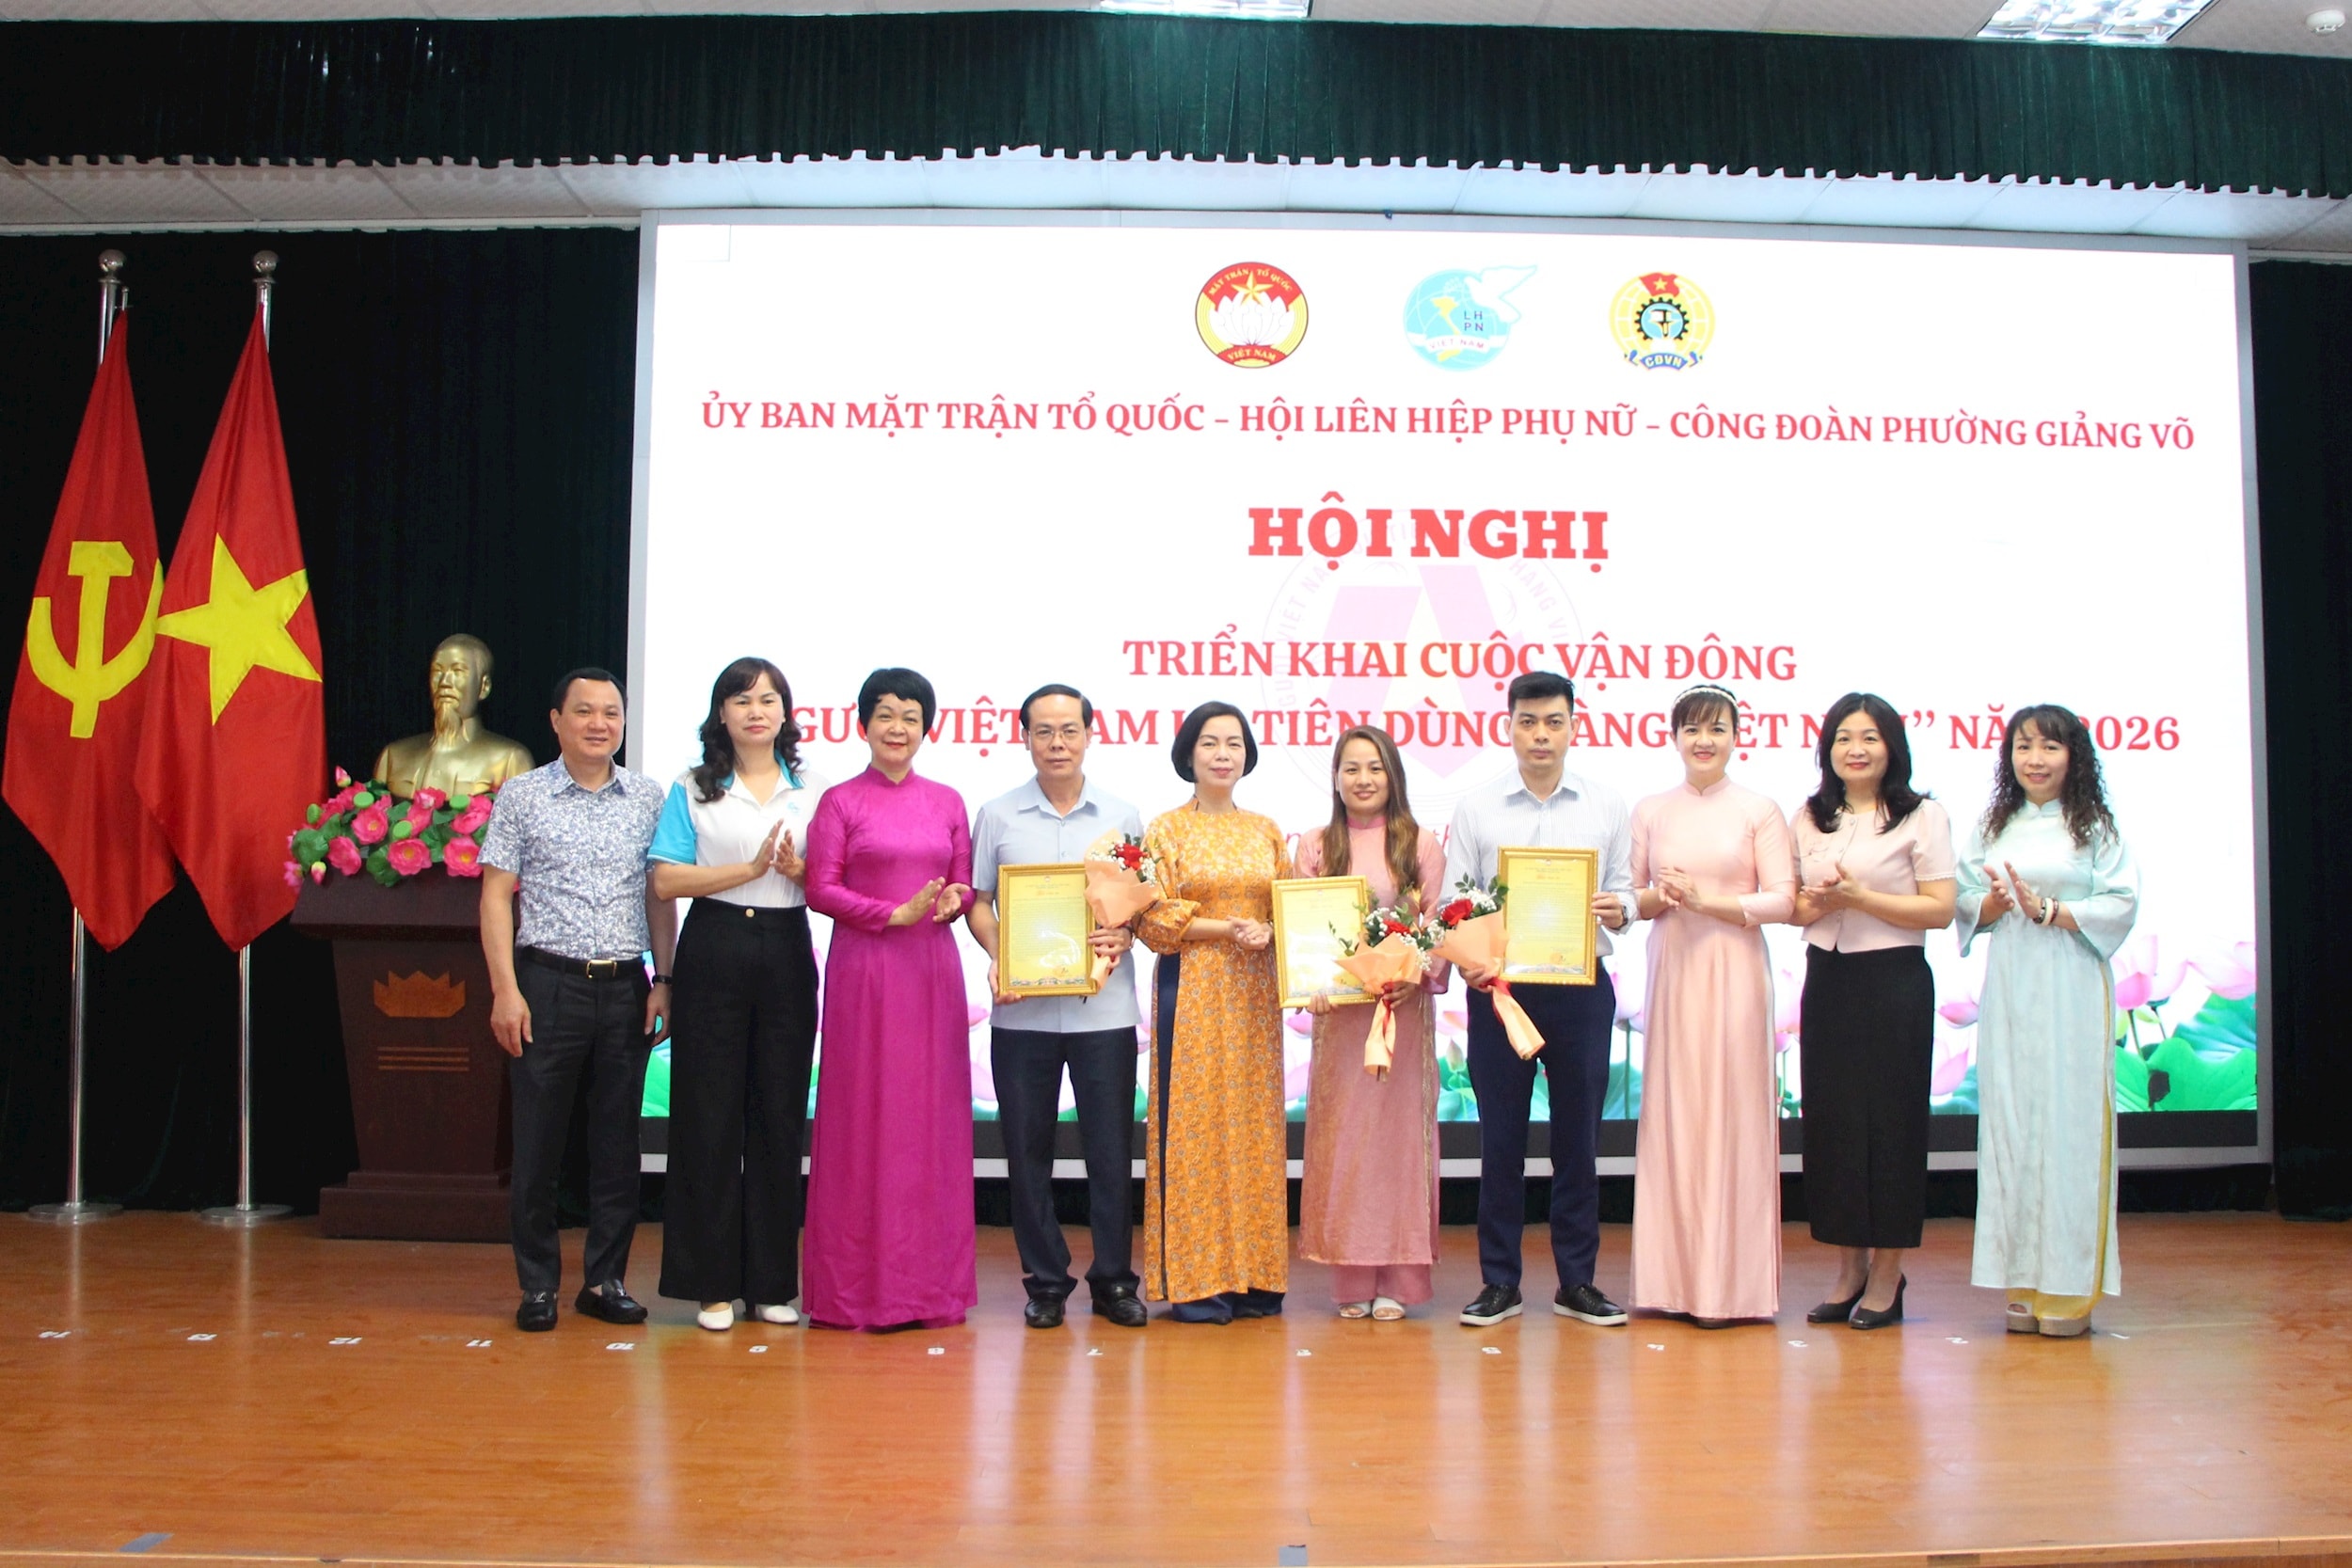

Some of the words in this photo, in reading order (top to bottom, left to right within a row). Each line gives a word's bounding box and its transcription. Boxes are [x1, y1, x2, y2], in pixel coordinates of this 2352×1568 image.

[1253, 348, 1278, 362] NAM
[704, 391, 751, 429] ỦY
[761, 402, 835, 429] BAN
[846, 394, 930, 438] MẶT
[937, 393, 1039, 439] TRẬN
[1047, 391, 1097, 430] TỔ
[1105, 393, 1205, 437] QUỐC
[1240, 396, 1304, 440] HỘI
[1314, 397, 1397, 434] LIÊN
[1407, 398, 1493, 443] HIỆP
[1502, 407, 1575, 444] PHỤ
[1585, 403, 1638, 437] NỮ
[1670, 403, 1766, 440] CÔNG
[1775, 405, 1872, 442] ĐOÀN
[1883, 409, 2027, 449] PHƯỜNG
[2035, 410, 2142, 450] GIẢNG
[2150, 415, 2195, 451] VÕ
[1248, 490, 1393, 571] HỘI
[1409, 508, 1609, 574] NGHỊ
[1122, 623, 1275, 677] TRIỂN
[1288, 641, 1406, 678] KHAI
[1420, 629, 1545, 691] CUỘC
[1553, 631, 1652, 692] VẬN
[1665, 632, 1797, 681] ĐÔNG
[1089, 708, 1160, 745] AM
[1568, 697, 1672, 749] ÀNG
[1734, 699, 1788, 761] ỆT
[1948, 704, 2009, 750] NĂ
[2080, 715, 2180, 751] 026
